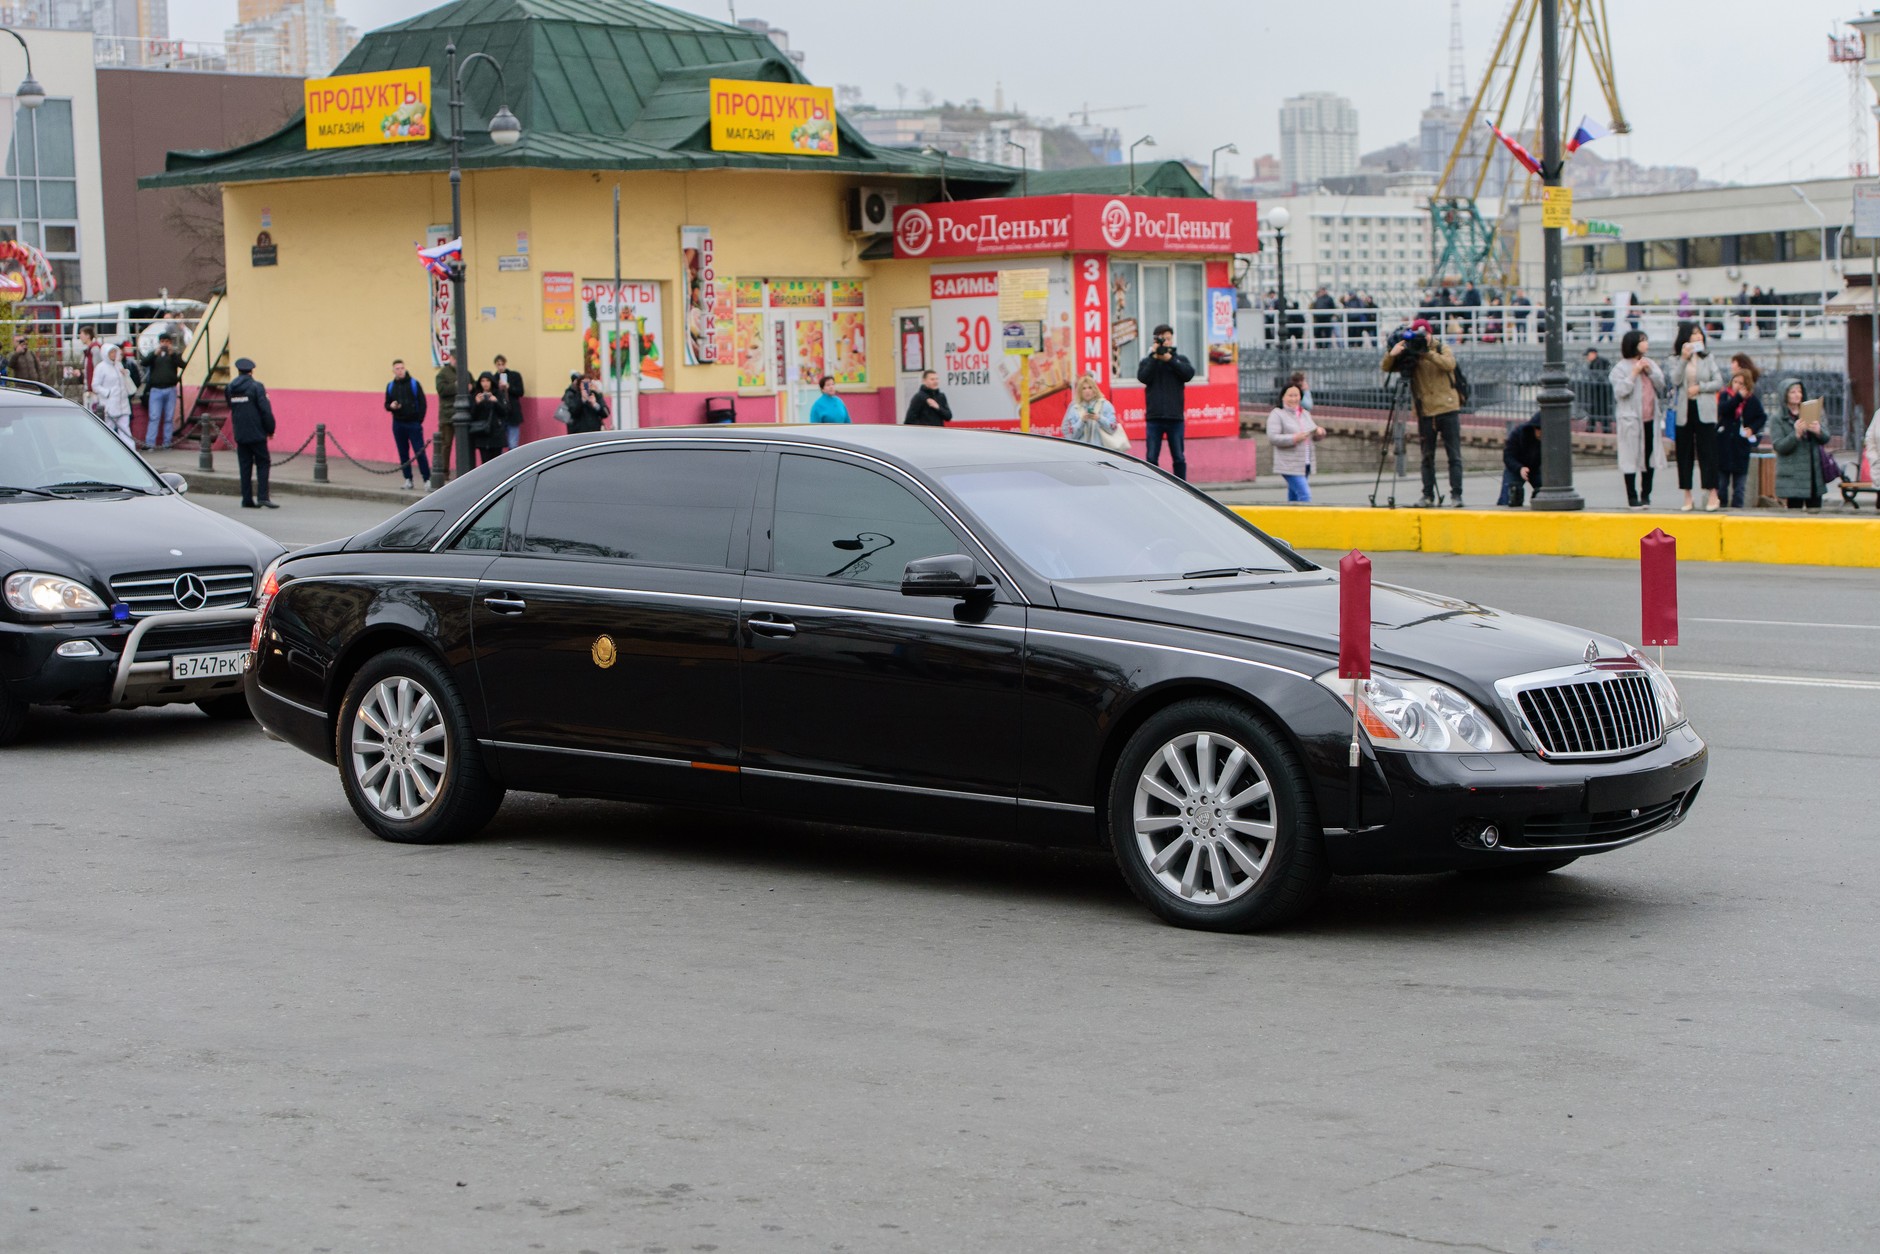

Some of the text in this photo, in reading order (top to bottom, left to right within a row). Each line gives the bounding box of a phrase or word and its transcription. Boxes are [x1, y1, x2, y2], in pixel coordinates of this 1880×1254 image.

[309, 80, 423, 115] ПРОДУКТЫ
[716, 92, 830, 122] ПРОДУКТЫ
[318, 121, 365, 136] МАГАЗИН
[726, 127, 775, 141] МАГАЗИН
[937, 214, 1069, 243] РосДеньги
[1133, 211, 1232, 241] РосДеньги
[581, 283, 655, 304] ФРУКТЫ
[934, 276, 998, 297] ЗАЙМЫ
[703, 239, 717, 360] ПРОДУКТЫ
[773, 295, 819, 306] ПРОДУКТЫ
[956, 315, 991, 353] 30
[945, 353, 990, 371] ТЫСЯЧ
[947, 370, 990, 386] РУБЛЕЙ
[179, 656, 238, 676] В747РК
